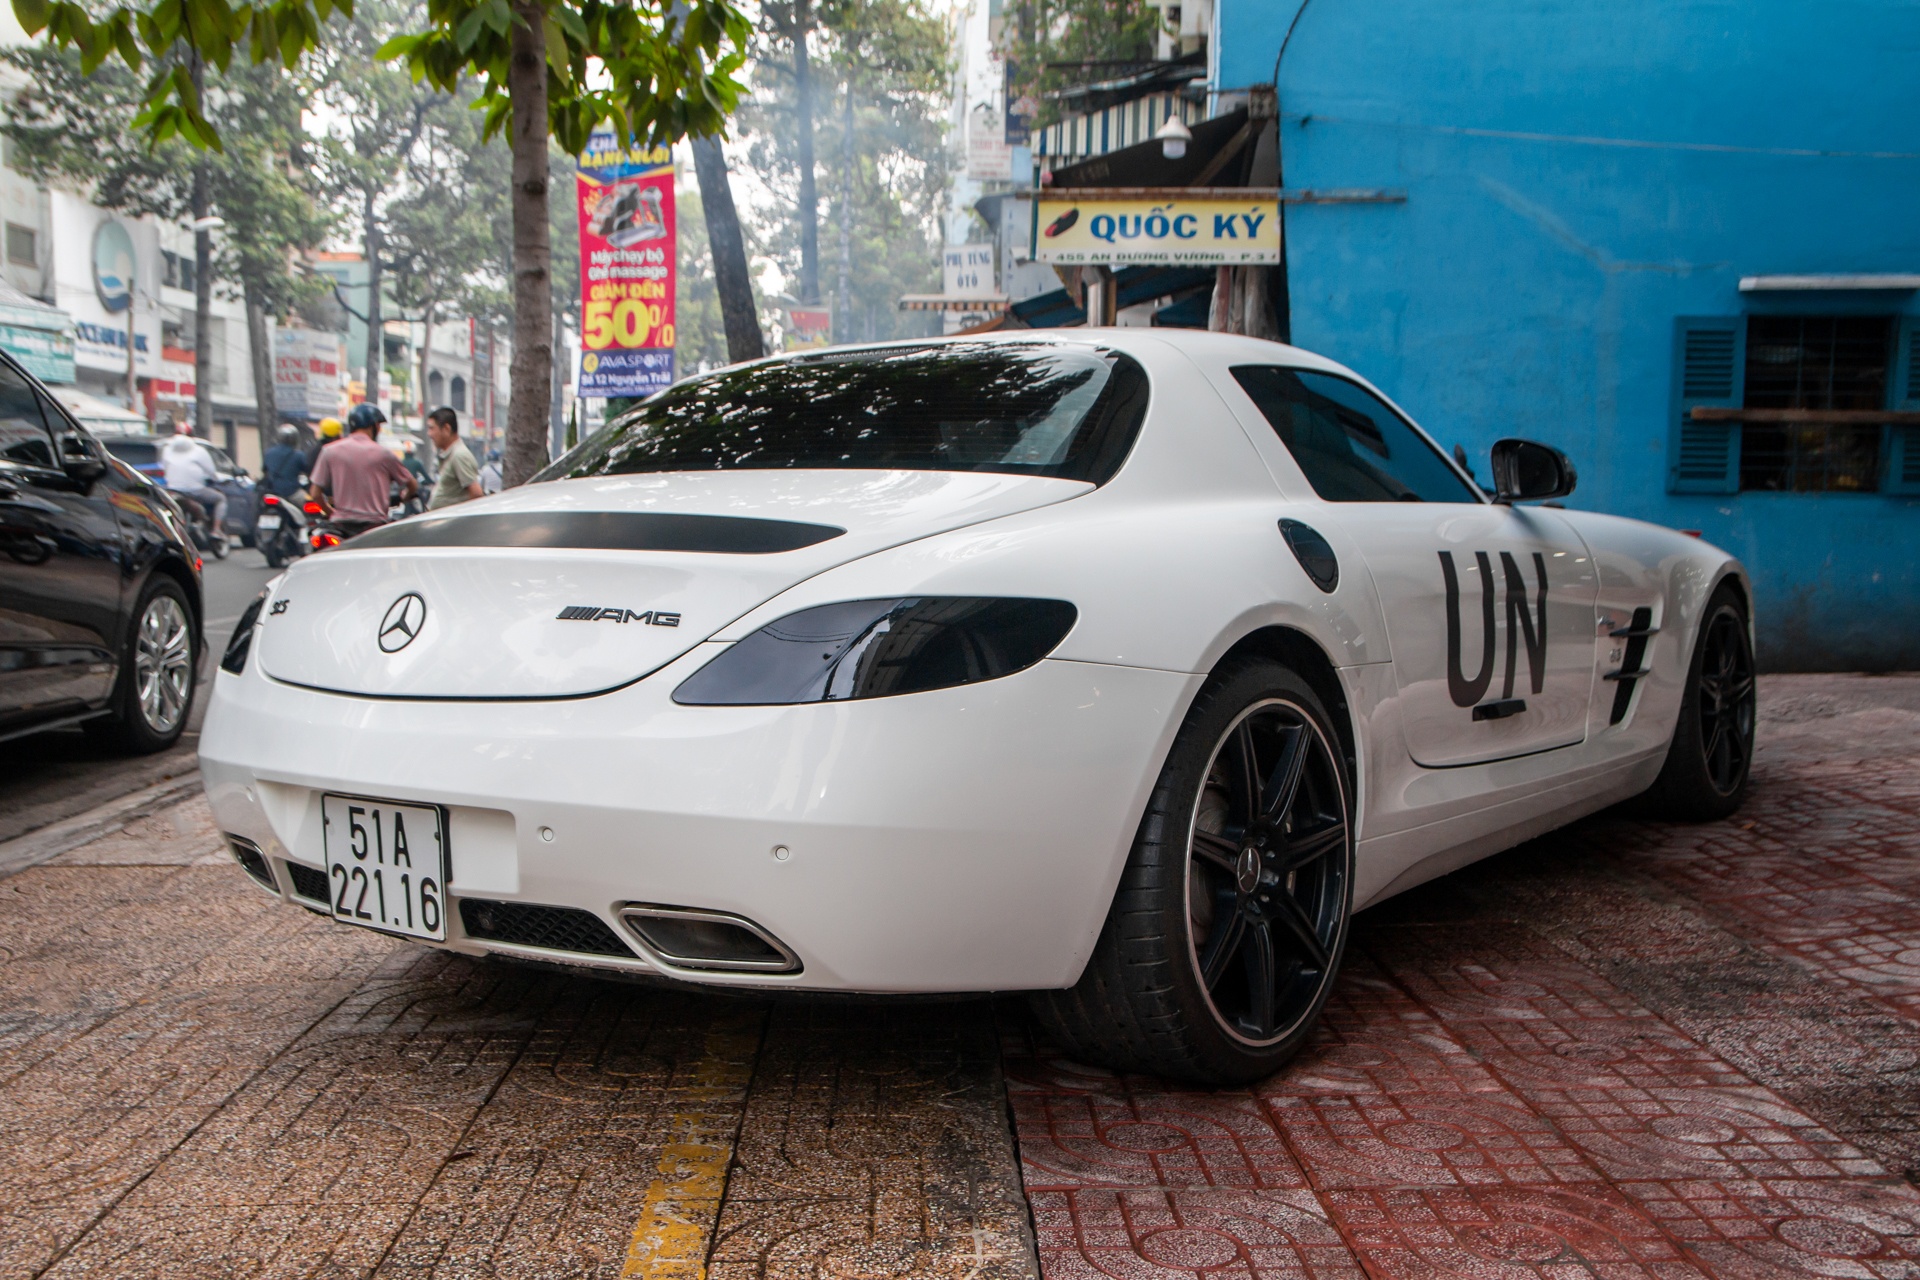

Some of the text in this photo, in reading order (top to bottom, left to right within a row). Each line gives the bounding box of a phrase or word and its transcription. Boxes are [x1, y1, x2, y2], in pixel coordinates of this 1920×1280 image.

[1090, 203, 1266, 243] QUỐC KÝ
[609, 265, 669, 281] massage
[1090, 251, 1112, 262] AN
[583, 298, 674, 350] 50%
[593, 607, 682, 627] AMG
[1438, 551, 1548, 707] UN
[348, 805, 412, 869] 51A
[331, 862, 440, 932] 221.16
